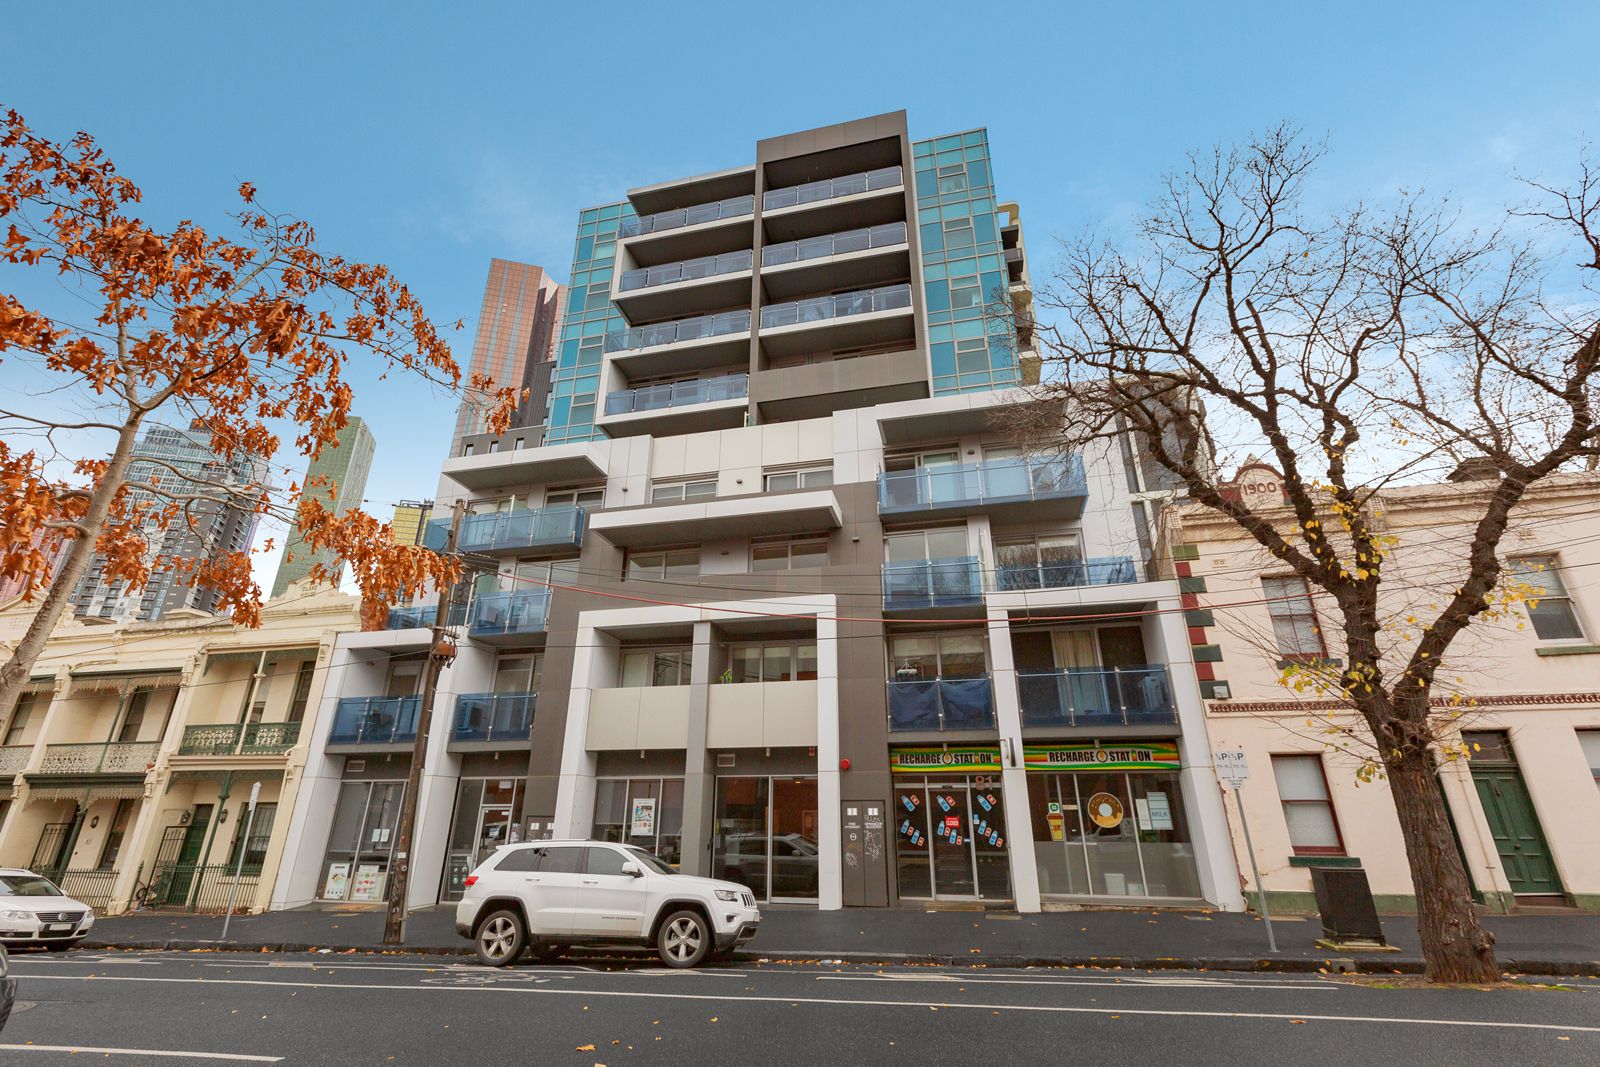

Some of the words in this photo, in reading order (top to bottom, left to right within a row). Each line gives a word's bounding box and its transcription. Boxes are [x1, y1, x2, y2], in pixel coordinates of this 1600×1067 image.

[1243, 482, 1276, 496] 1900
[899, 752, 941, 765] RECHARGE
[1049, 751, 1094, 763] RECHARGE
[975, 775, 993, 791] 81
